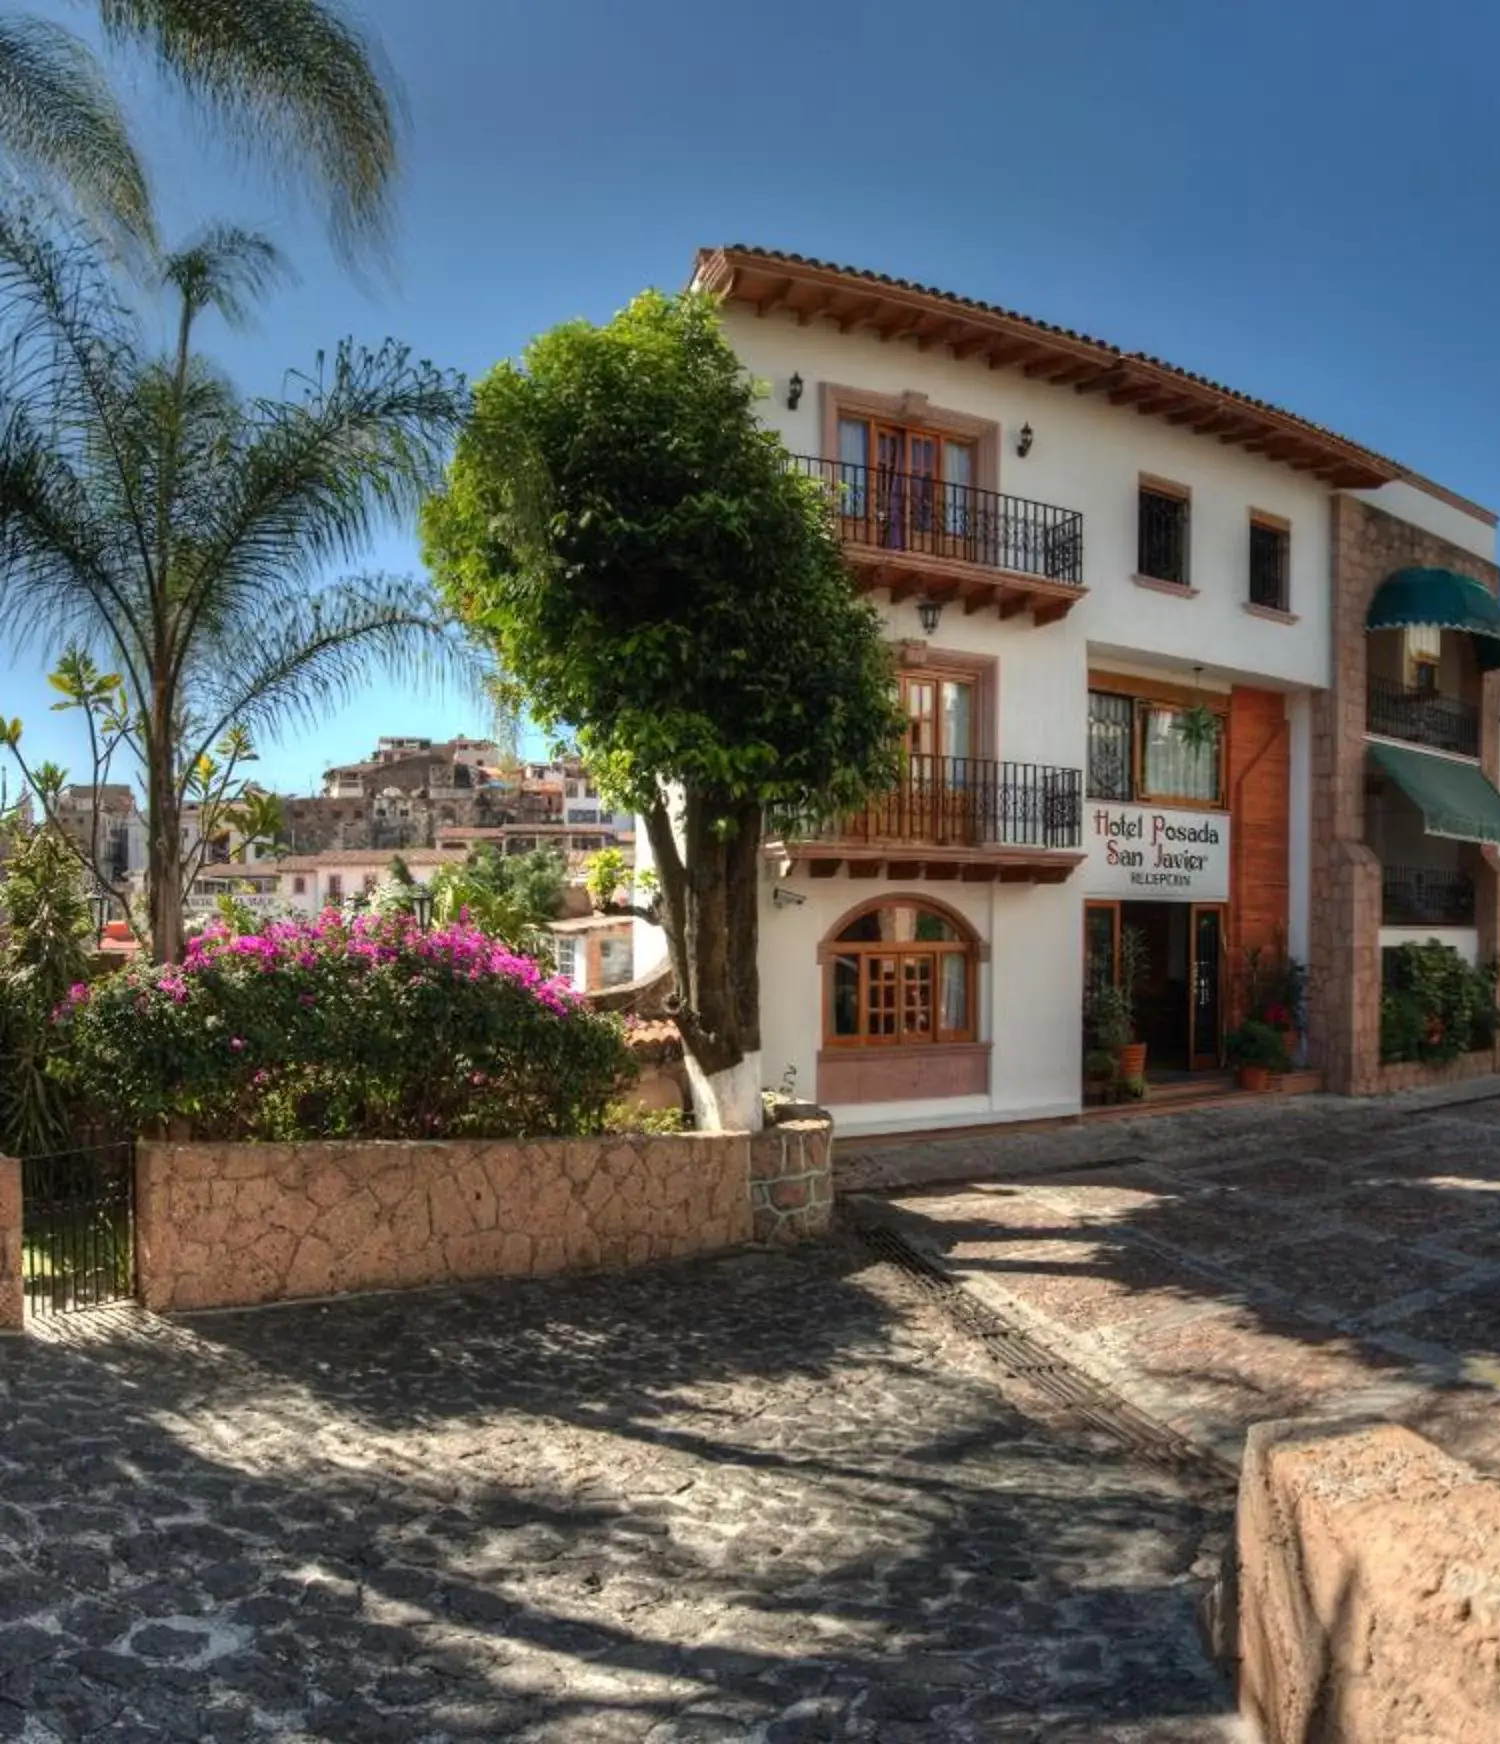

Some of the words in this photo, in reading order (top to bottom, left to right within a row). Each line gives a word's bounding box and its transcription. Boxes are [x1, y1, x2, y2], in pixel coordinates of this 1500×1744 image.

[1093, 809, 1143, 840] Hotel
[1150, 815, 1219, 846] Posada
[1106, 839, 1143, 866] San
[1153, 843, 1208, 872] Javier
